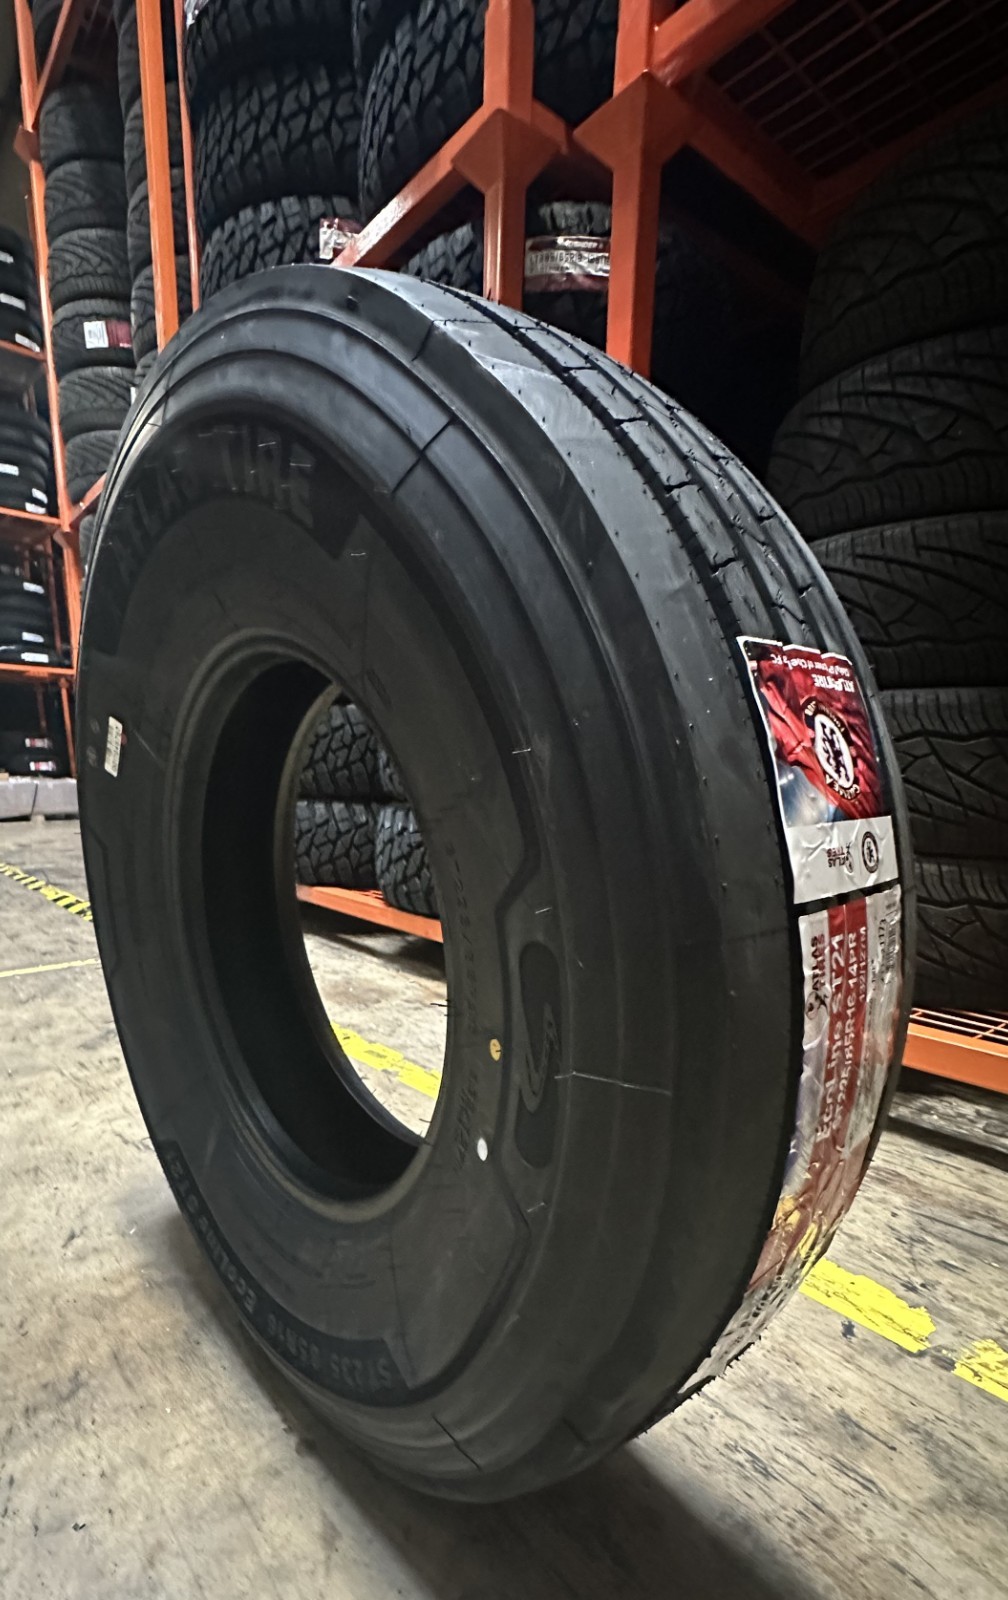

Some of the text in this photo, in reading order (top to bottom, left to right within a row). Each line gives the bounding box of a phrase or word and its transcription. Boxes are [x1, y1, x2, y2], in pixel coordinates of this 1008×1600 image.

[811, 935, 819, 991] ATLAS
[847, 932, 858, 988] 14PR
[815, 933, 845, 1142] EcoLine ST21
